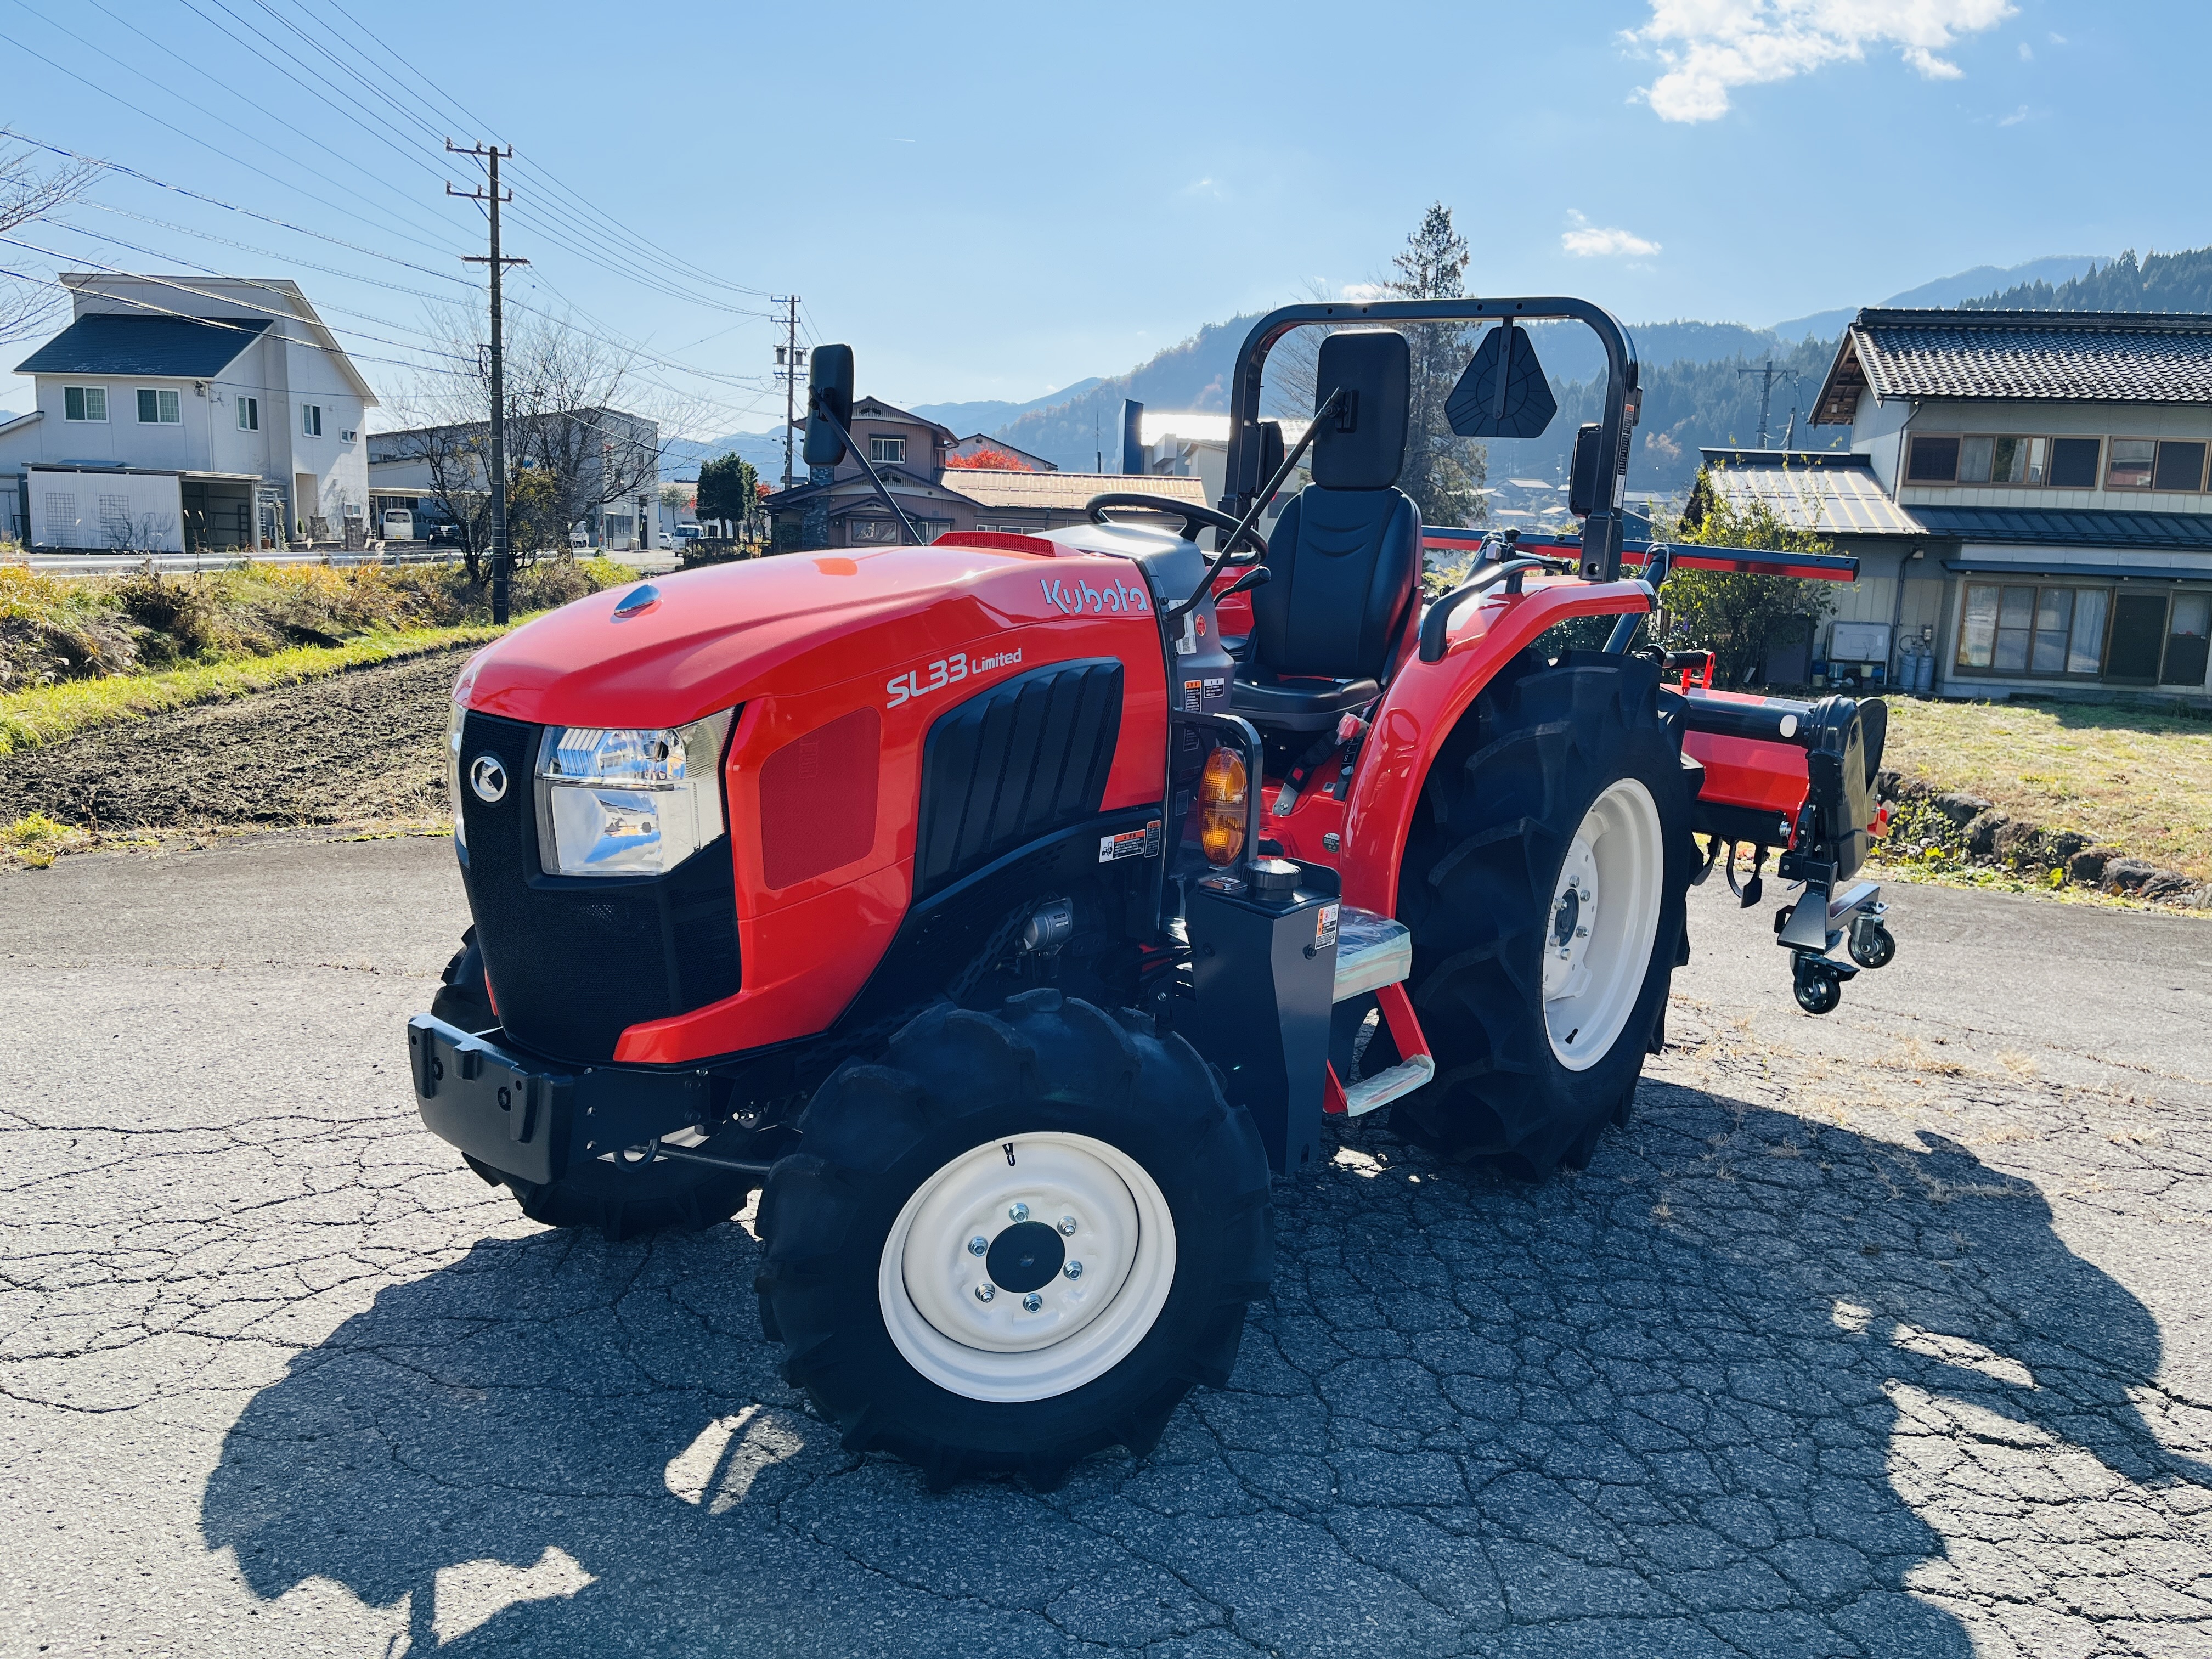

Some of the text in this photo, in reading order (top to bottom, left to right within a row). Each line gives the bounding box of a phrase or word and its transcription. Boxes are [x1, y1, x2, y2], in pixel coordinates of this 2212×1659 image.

[1040, 579, 1148, 613] Kubota
[887, 647, 1022, 709] SL33 Limited
